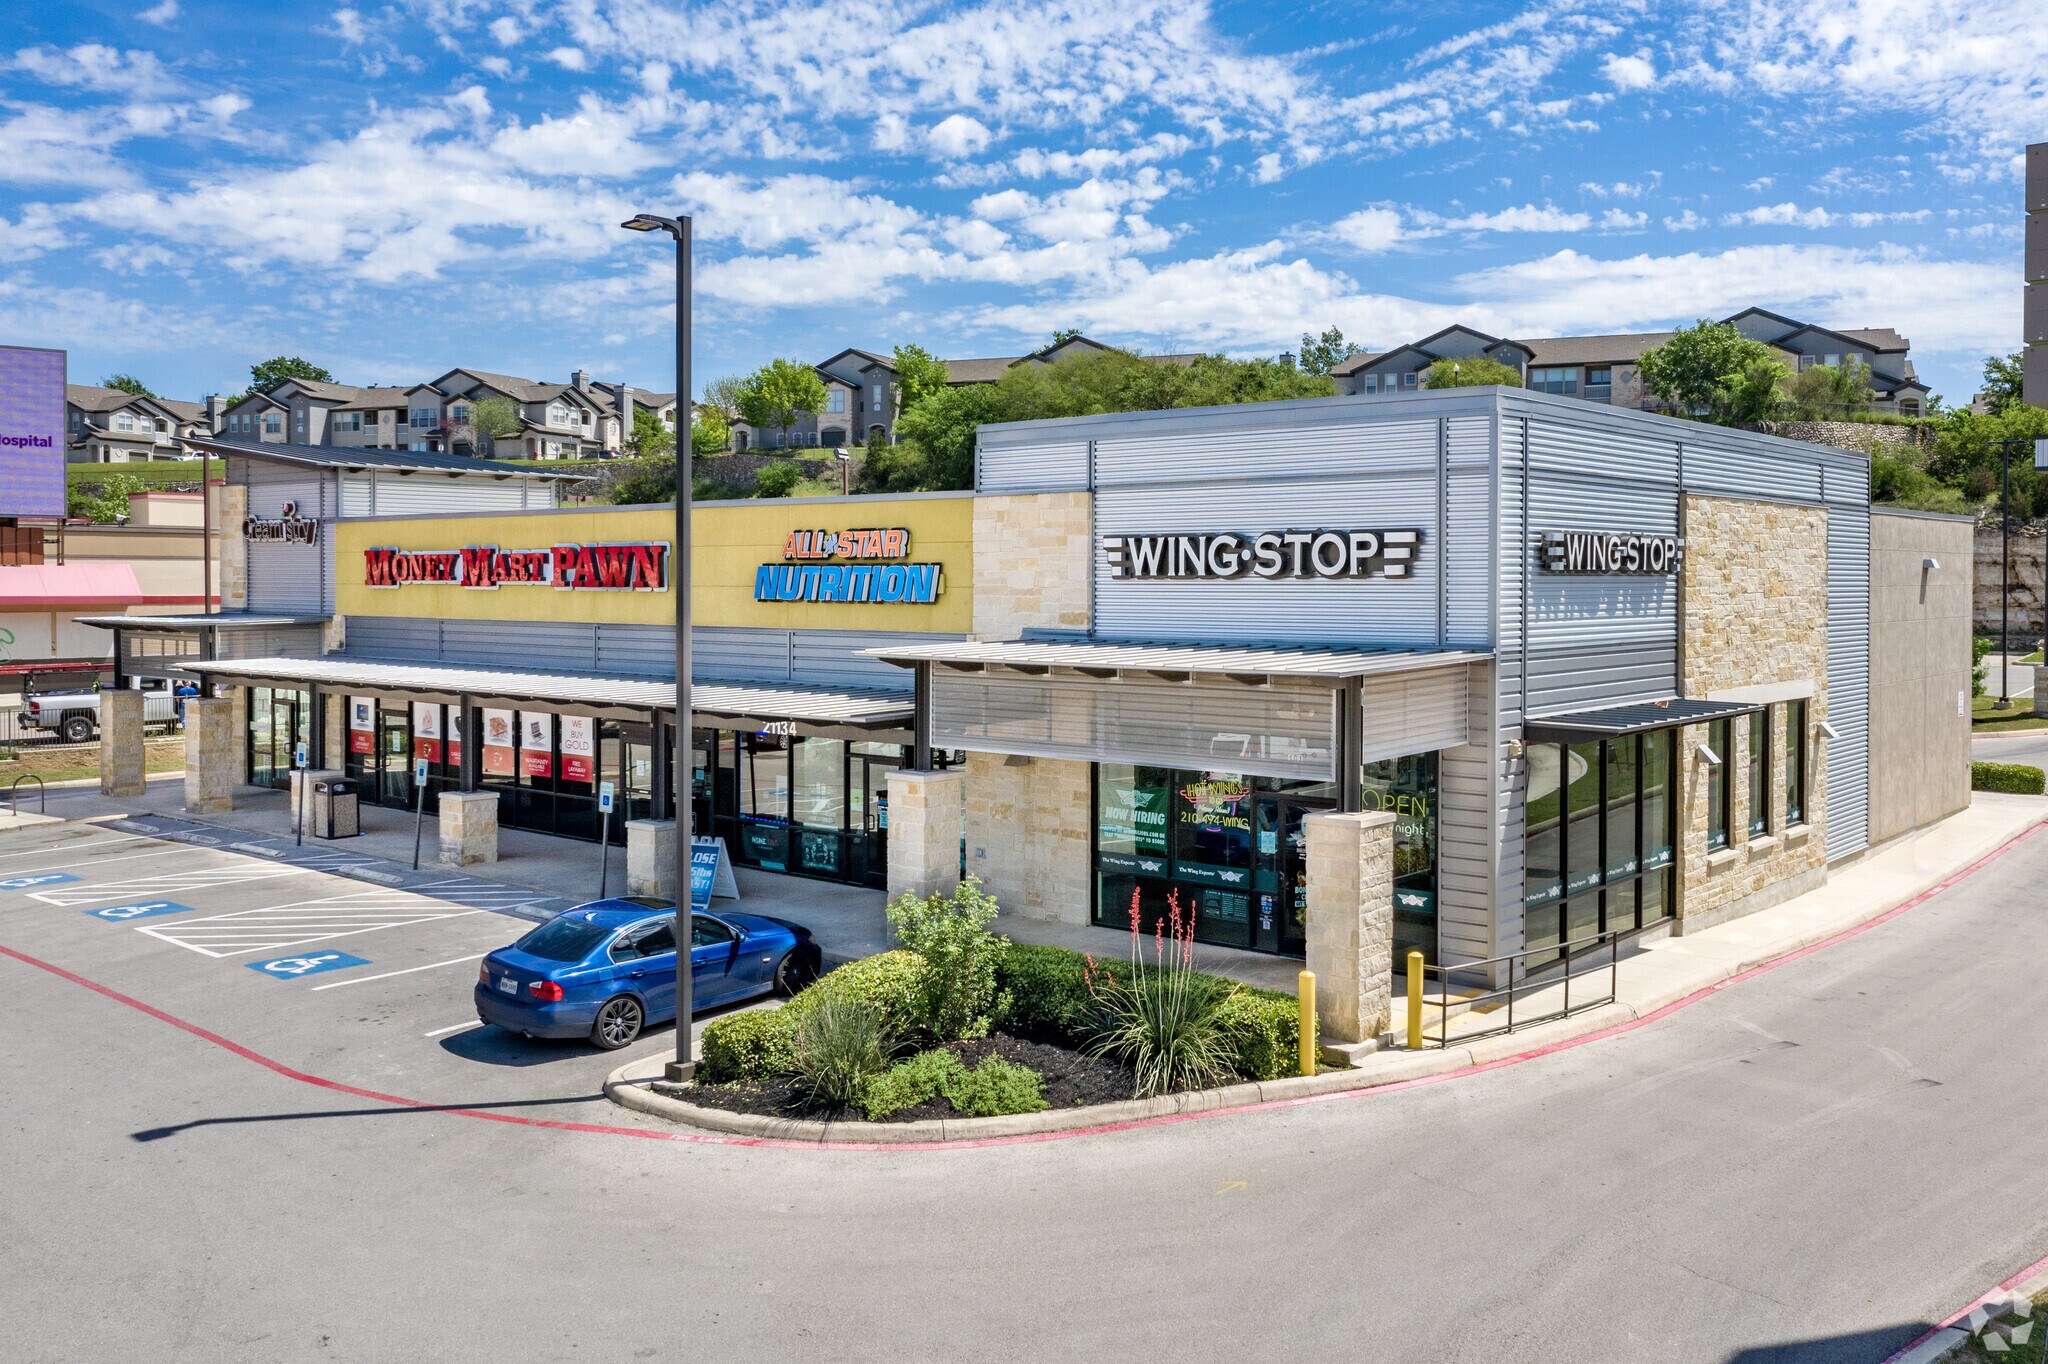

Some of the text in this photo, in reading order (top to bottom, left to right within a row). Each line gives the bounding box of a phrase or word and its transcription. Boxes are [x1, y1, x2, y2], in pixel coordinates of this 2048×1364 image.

[0, 434, 52, 449] ospital
[243, 503, 317, 547] Creamistry
[781, 529, 908, 558] ALL STAR
[364, 545, 662, 588] MONEY MART PAWN
[754, 564, 939, 603] NUTRITION
[571, 719, 583, 728] WE
[762, 721, 797, 736] 21134
[570, 730, 584, 739] BUY
[564, 739, 589, 751] GOLD
[1362, 788, 1426, 818] OPEN
[1105, 806, 1166, 826] NOW HIRING
[698, 1136, 725, 1144] LANE
